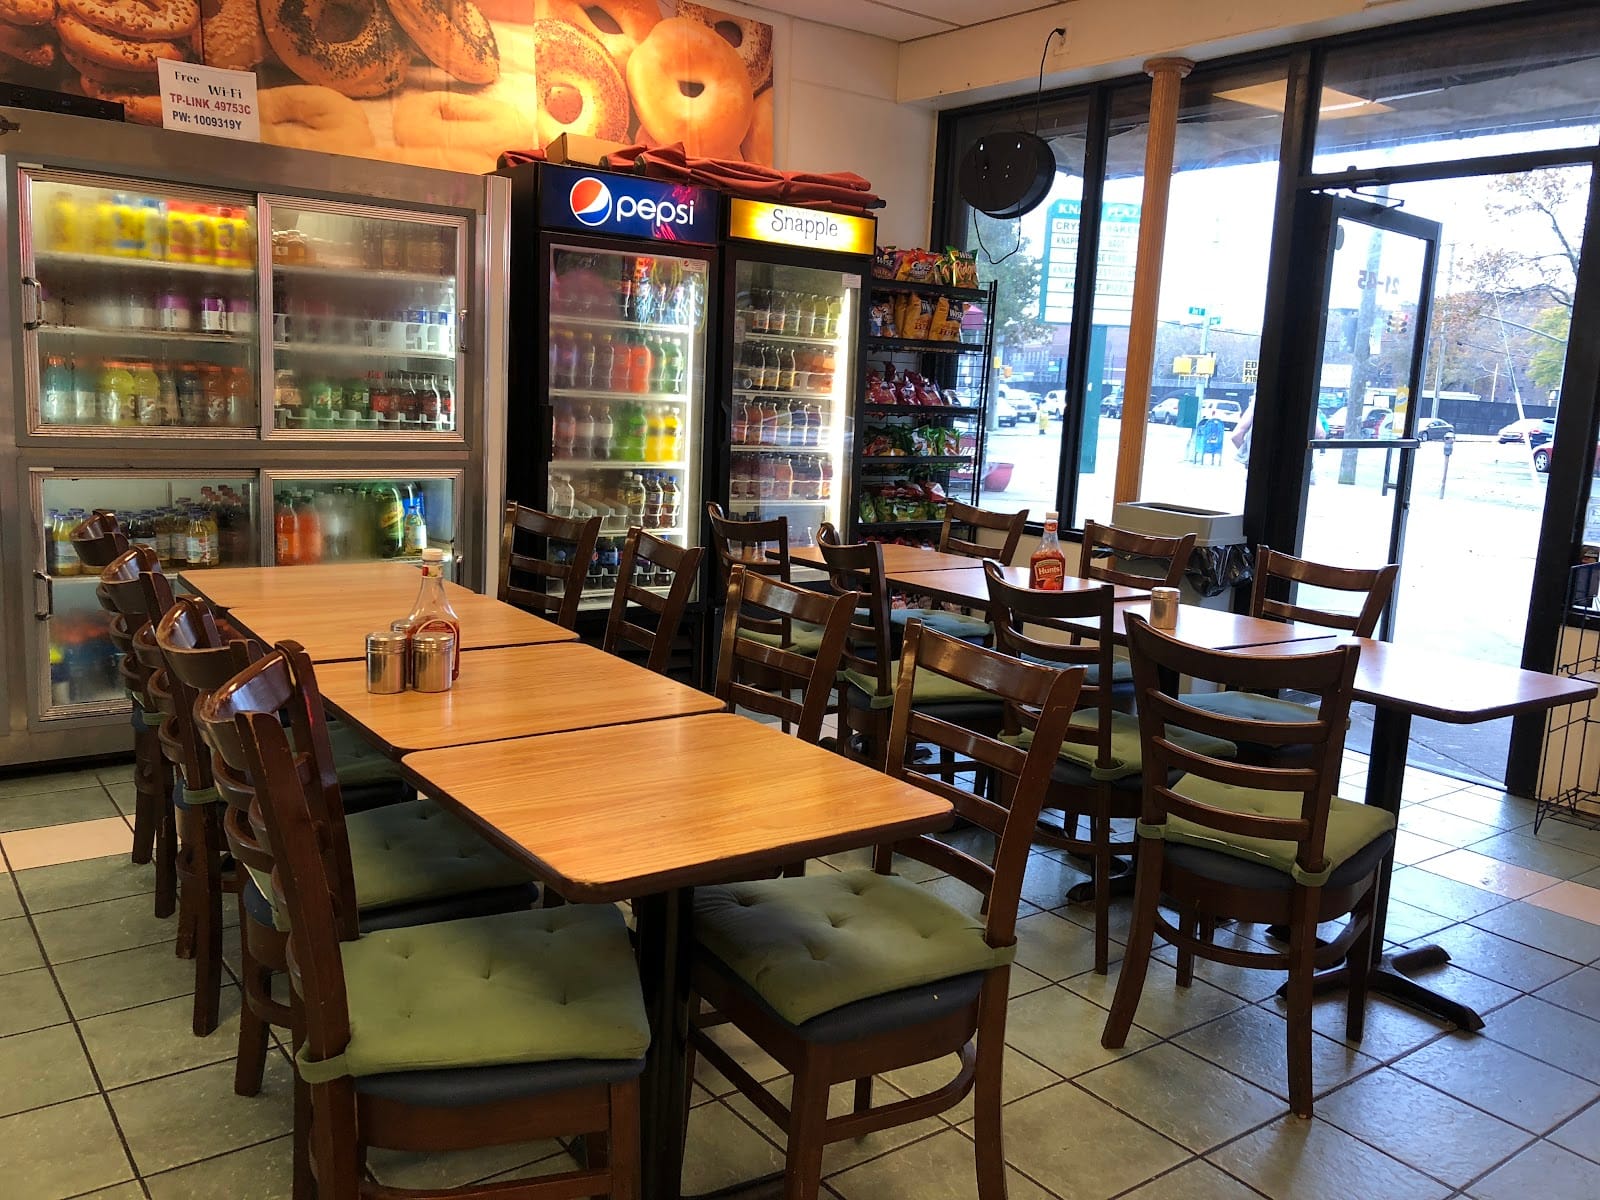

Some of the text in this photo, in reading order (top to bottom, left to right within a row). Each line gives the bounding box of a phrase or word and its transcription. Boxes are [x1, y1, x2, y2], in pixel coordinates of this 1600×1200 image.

[174, 70, 200, 84] Free
[207, 84, 242, 99] Wi-Fi
[172, 110, 242, 130] PW: 1009319Y
[616, 195, 695, 227] pepsi
[771, 208, 838, 240] Snapple
